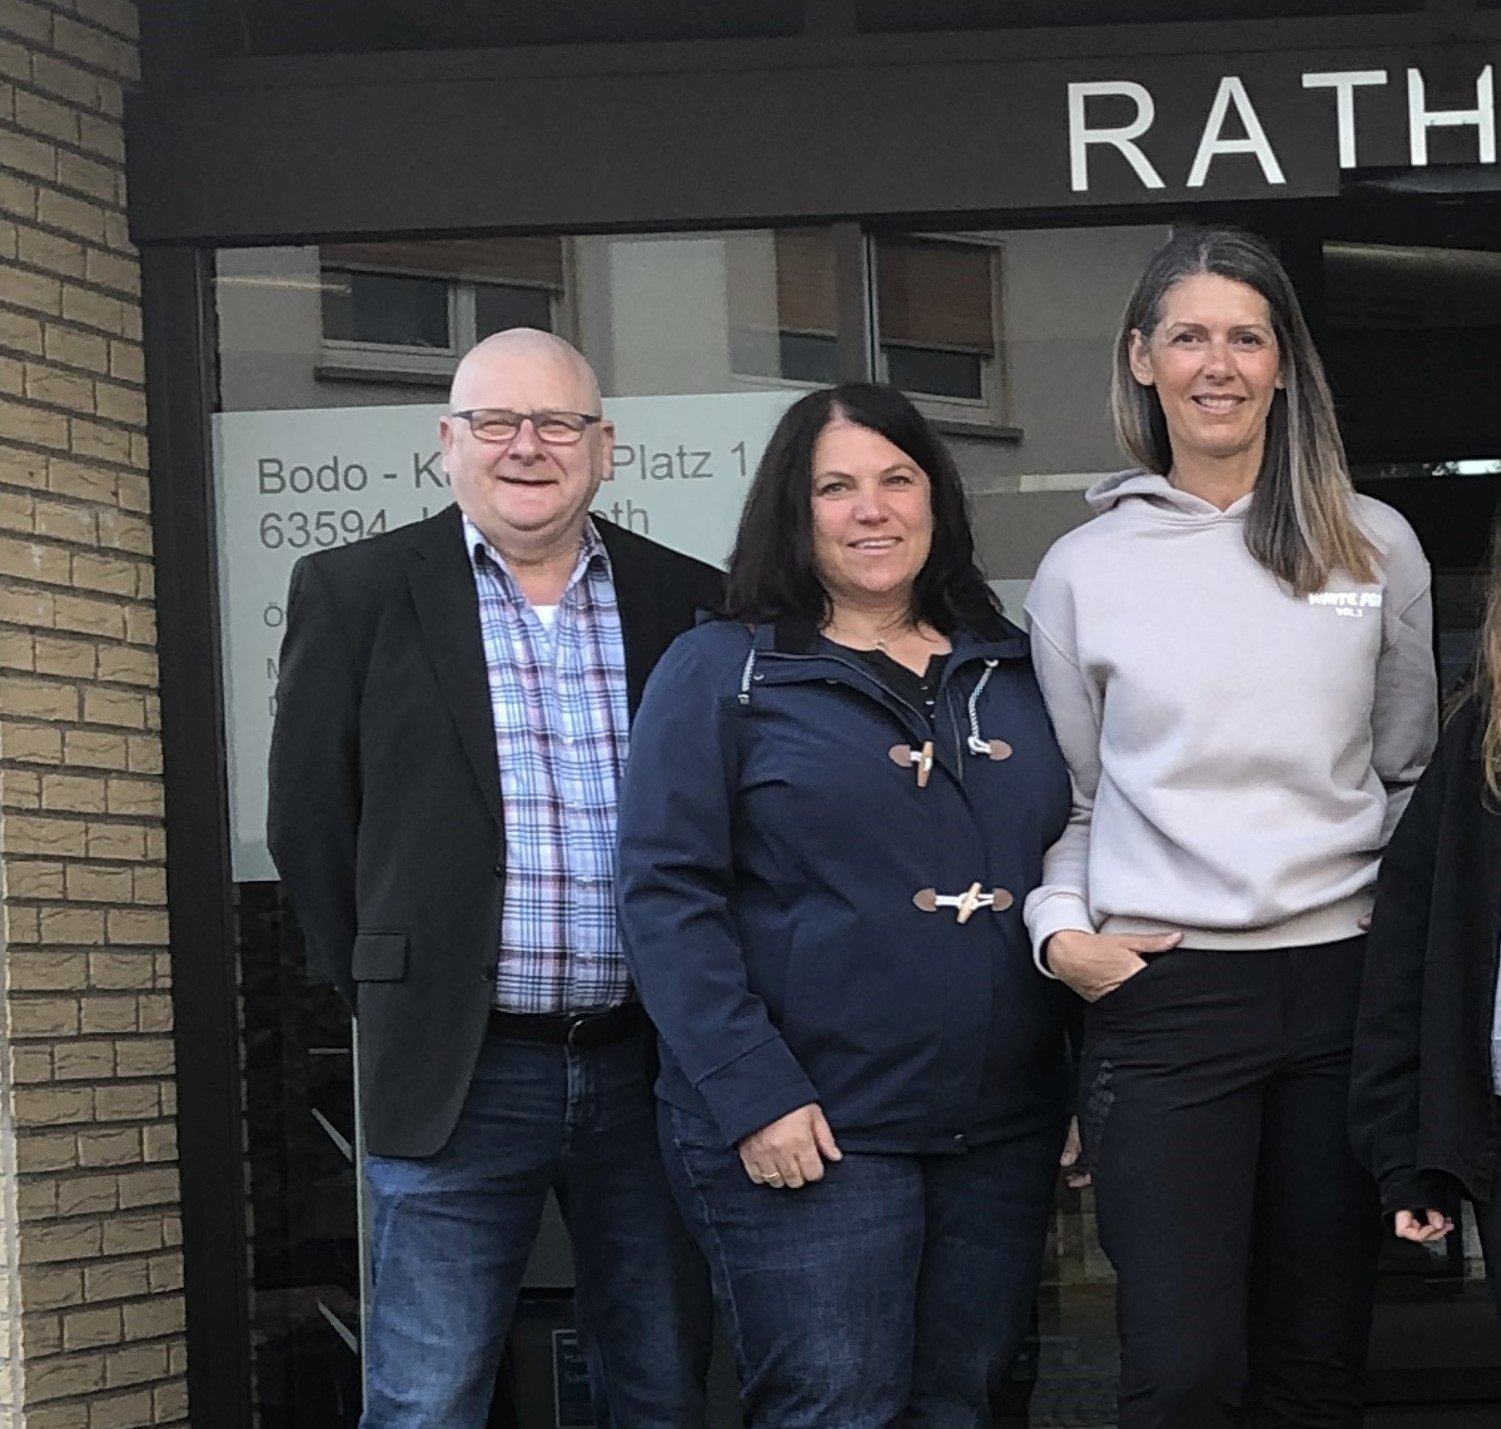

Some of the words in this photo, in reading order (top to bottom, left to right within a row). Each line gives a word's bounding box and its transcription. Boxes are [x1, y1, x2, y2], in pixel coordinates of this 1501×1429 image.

[258, 455, 367, 494] Bodo
[730, 440, 746, 477] 1
[260, 508, 387, 549] 63594
